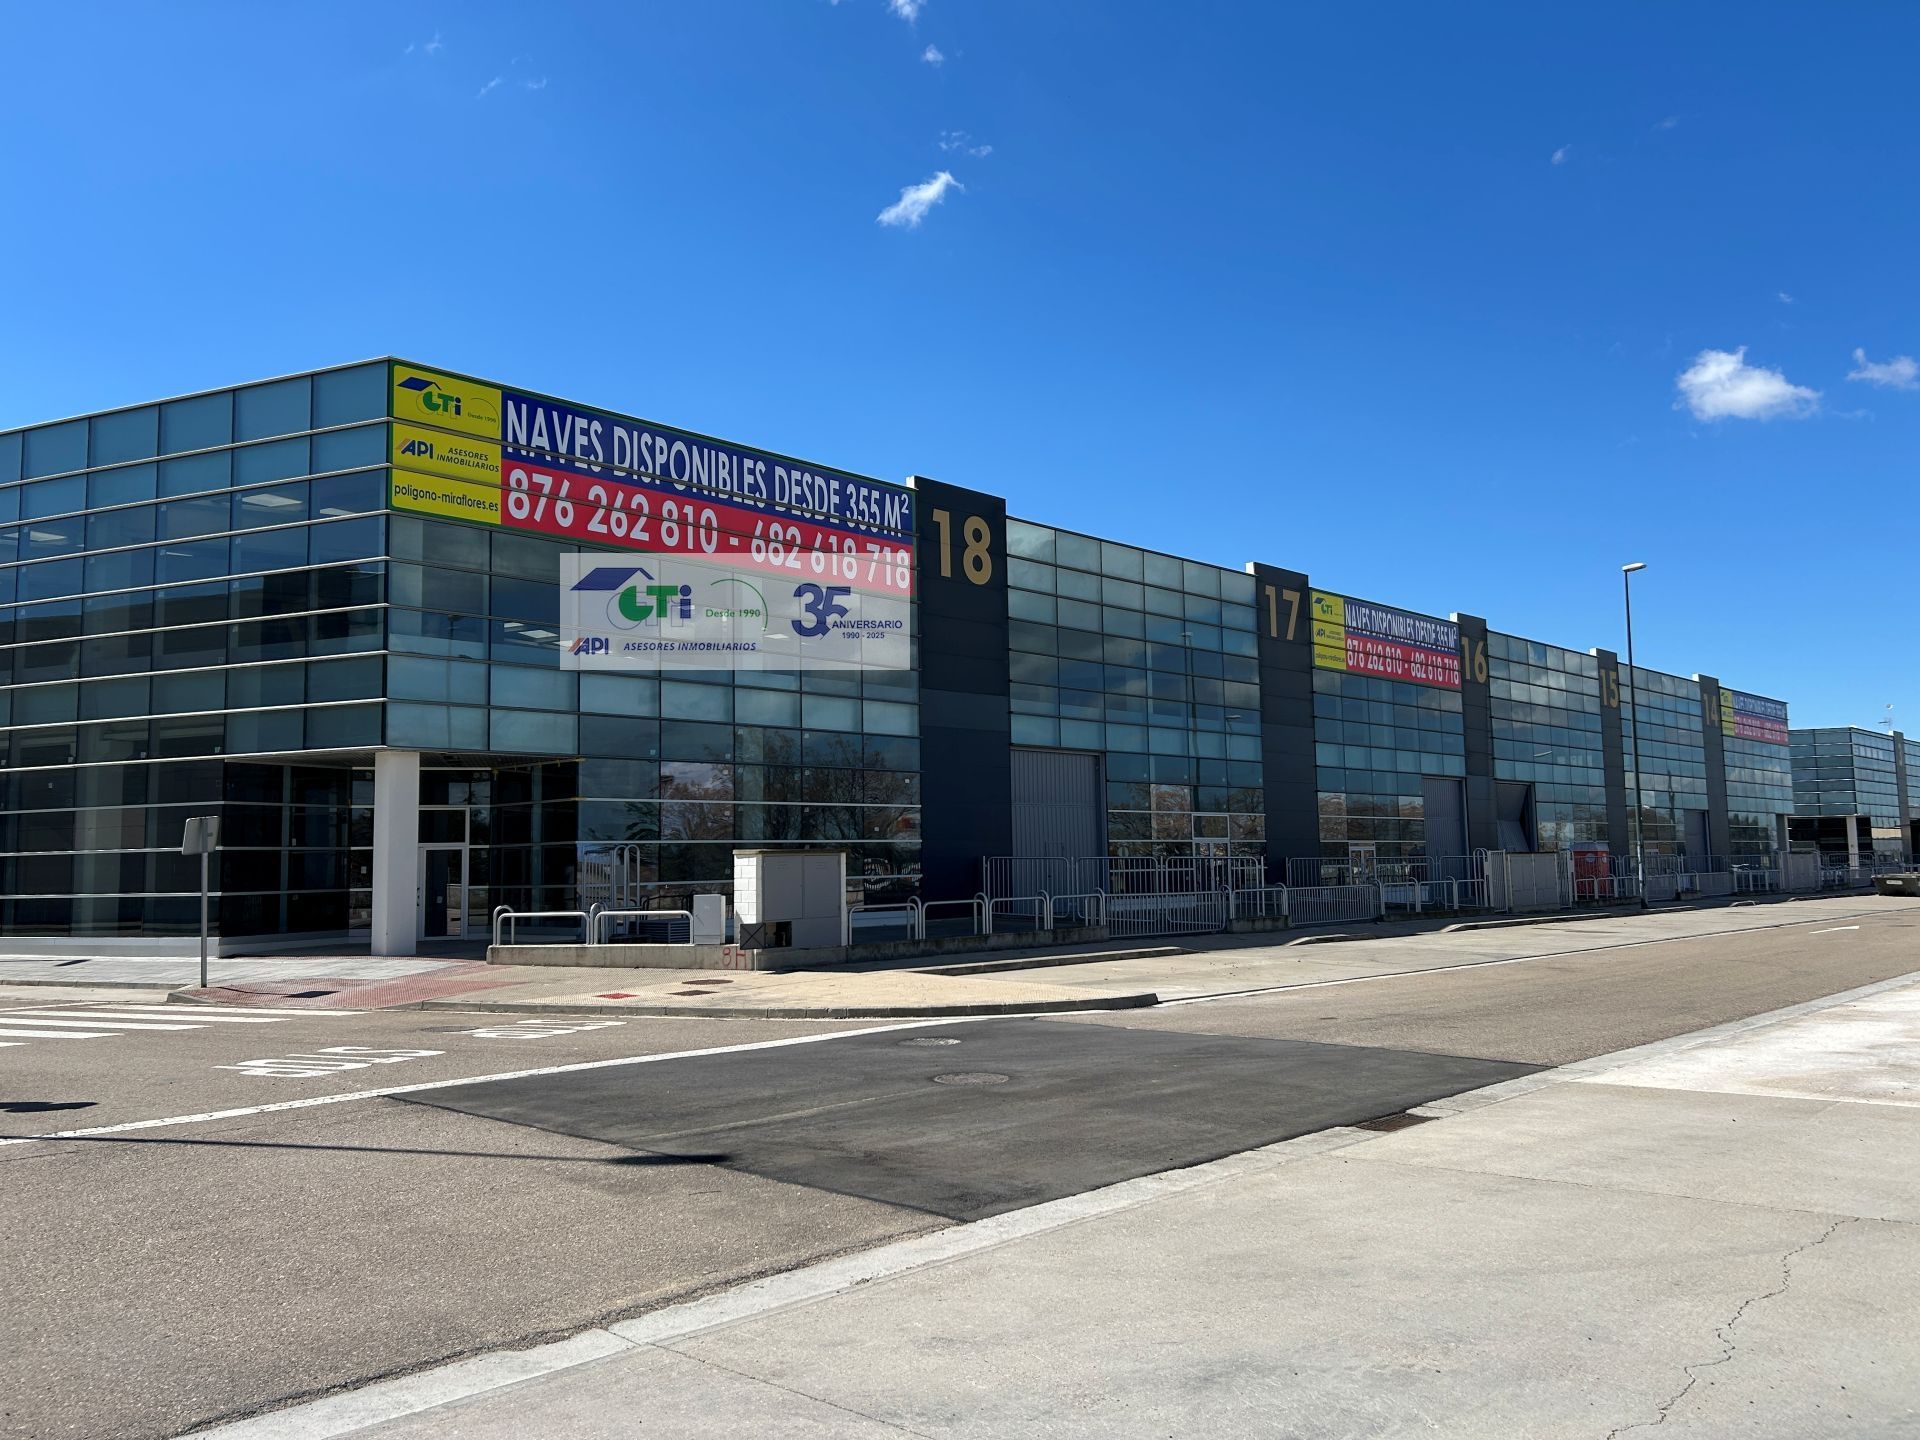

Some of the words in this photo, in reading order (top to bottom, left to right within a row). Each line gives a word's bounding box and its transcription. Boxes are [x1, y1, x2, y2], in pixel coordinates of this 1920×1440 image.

[400, 439, 434, 460] API
[436, 453, 500, 473] INMOBILIARIOS
[448, 447, 489, 462] ASESORES
[507, 399, 604, 473] NAVES
[613, 425, 767, 509] DISPONIBLES
[774, 465, 840, 523] DESDE
[846, 483, 881, 533] 355
[394, 484, 499, 512] poligono-miraflores.es
[507, 468, 574, 528] 876
[587, 485, 650, 541] 262
[660, 500, 718, 554] 810
[751, 520, 802, 569] 682
[810, 531, 858, 580] 618
[866, 543, 910, 589] 718
[932, 508, 993, 586] 18
[1265, 584, 1301, 641] 17
[1344, 603, 1370, 635] NAVES
[1371, 609, 1414, 644] DISPONIBLES
[1415, 620, 1436, 649] DESDE
[1346, 638, 1364, 668] 876
[1366, 642, 1384, 671] 262
[1386, 646, 1402, 675] 810
[1461, 636, 1488, 684] 16
[1600, 668, 1619, 708] 15
[1703, 693, 1718, 727] 14
[211, 1046, 446, 1078] STOP
